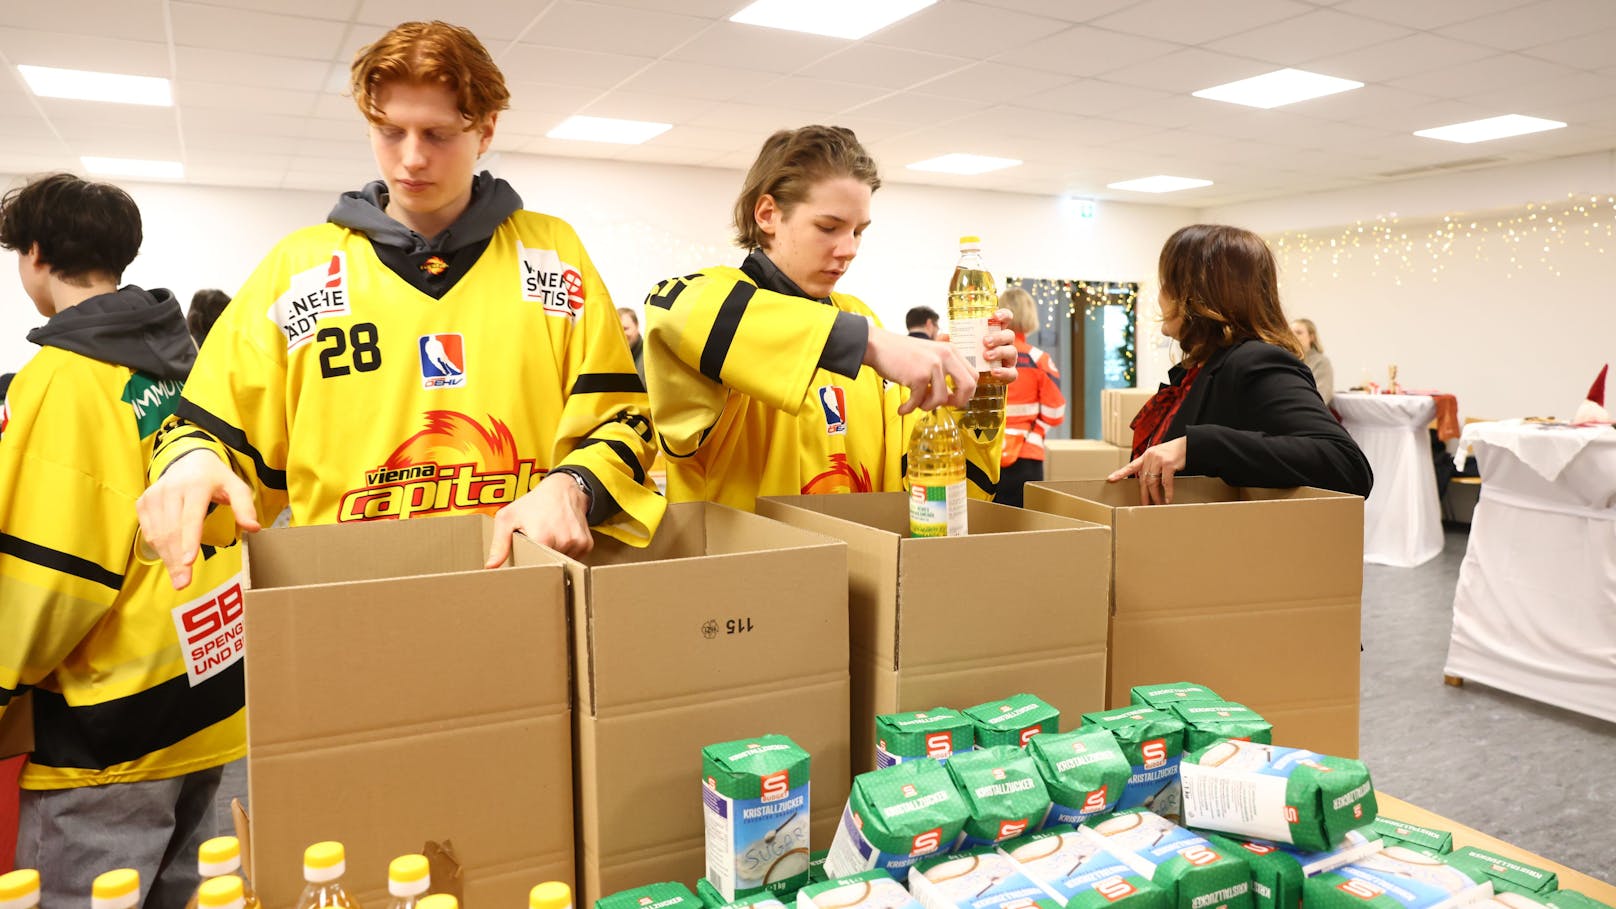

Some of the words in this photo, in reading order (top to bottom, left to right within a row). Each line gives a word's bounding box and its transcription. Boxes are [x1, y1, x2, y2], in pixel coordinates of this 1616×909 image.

[316, 322, 382, 379] 28
[367, 464, 435, 486] vienna
[726, 617, 754, 635] 115
[194, 647, 232, 676] UND
[742, 796, 804, 819] KRISTALLZUCKER
[1191, 881, 1248, 909] KRISTALLZUCKER
